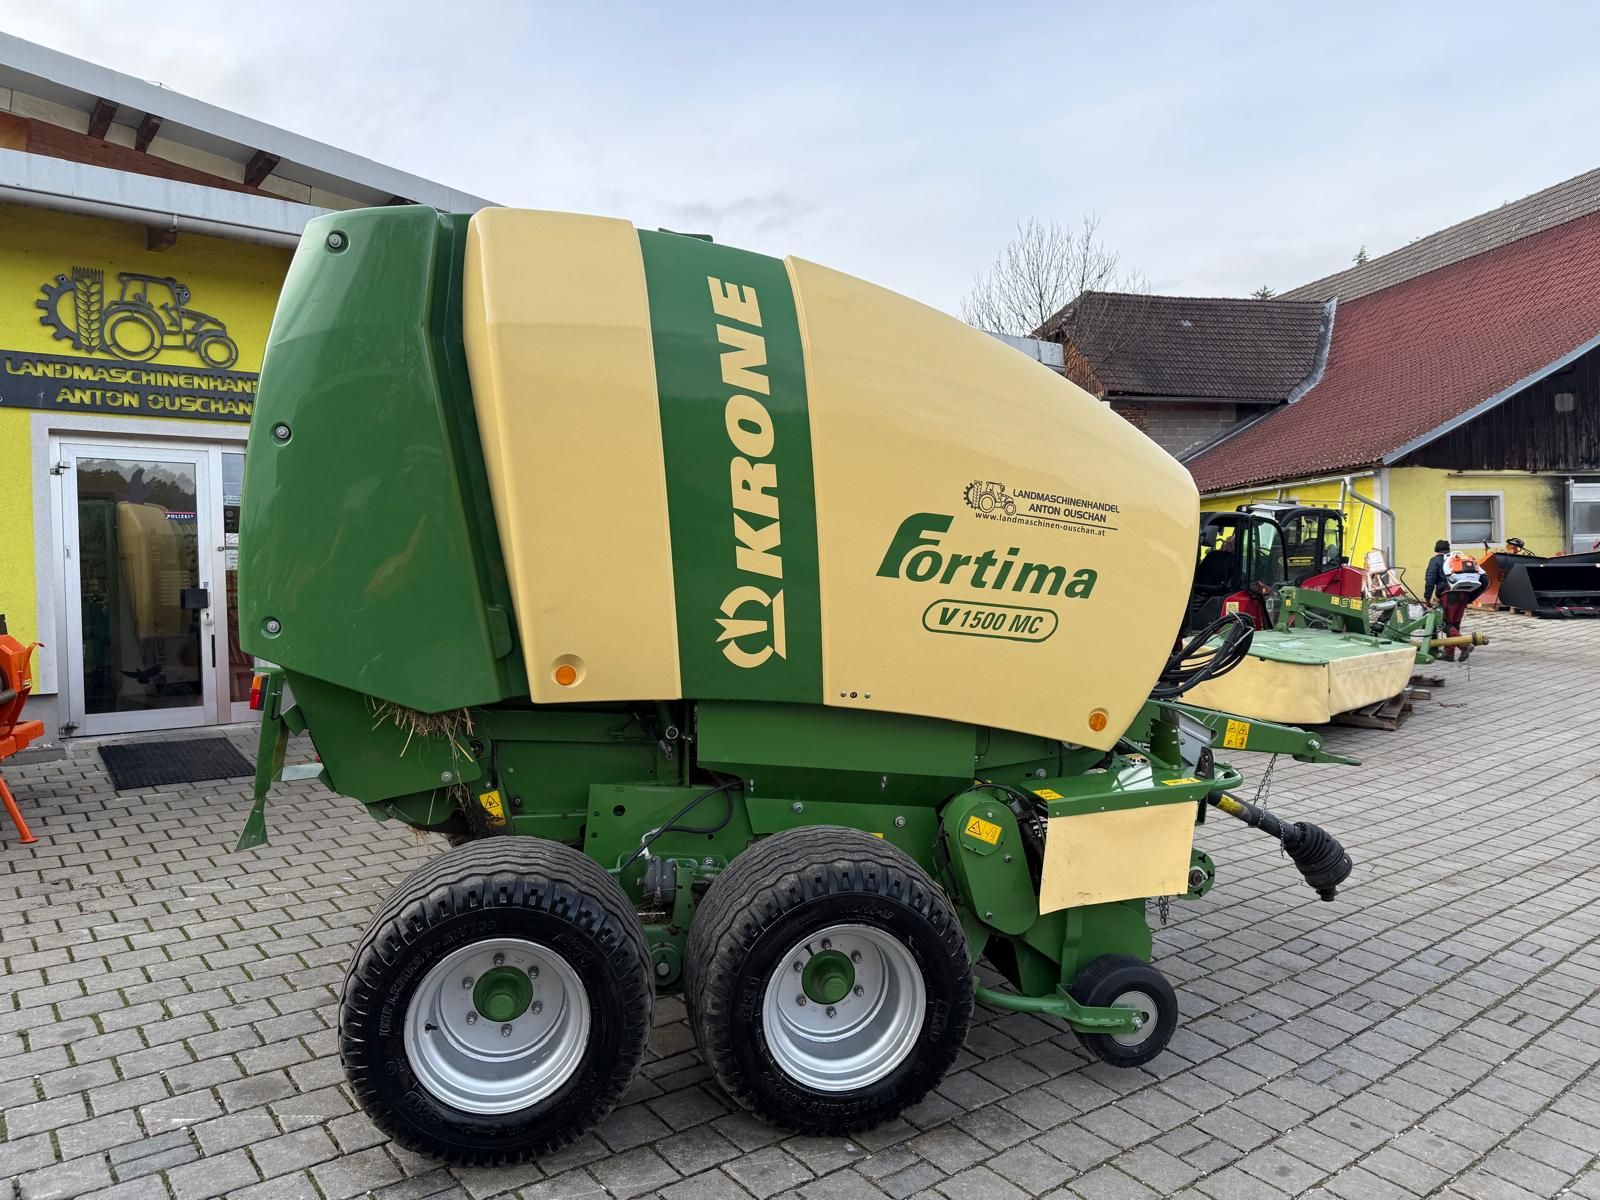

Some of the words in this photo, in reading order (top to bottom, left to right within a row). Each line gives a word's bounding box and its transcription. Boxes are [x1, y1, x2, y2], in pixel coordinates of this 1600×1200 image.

[56, 386, 140, 408] ANTON
[147, 393, 252, 416] OUSCHAN
[707, 275, 783, 579] KRONE
[1013, 488, 1120, 514] LANDMASCHINENHANDEL
[1028, 503, 1061, 516] ANTON
[1063, 508, 1107, 523] OUSCHAN
[975, 511, 1106, 536] www.landmaschinen-ouschan.at
[875, 512, 1098, 600] Fortima
[1008, 614, 1044, 634] MC
